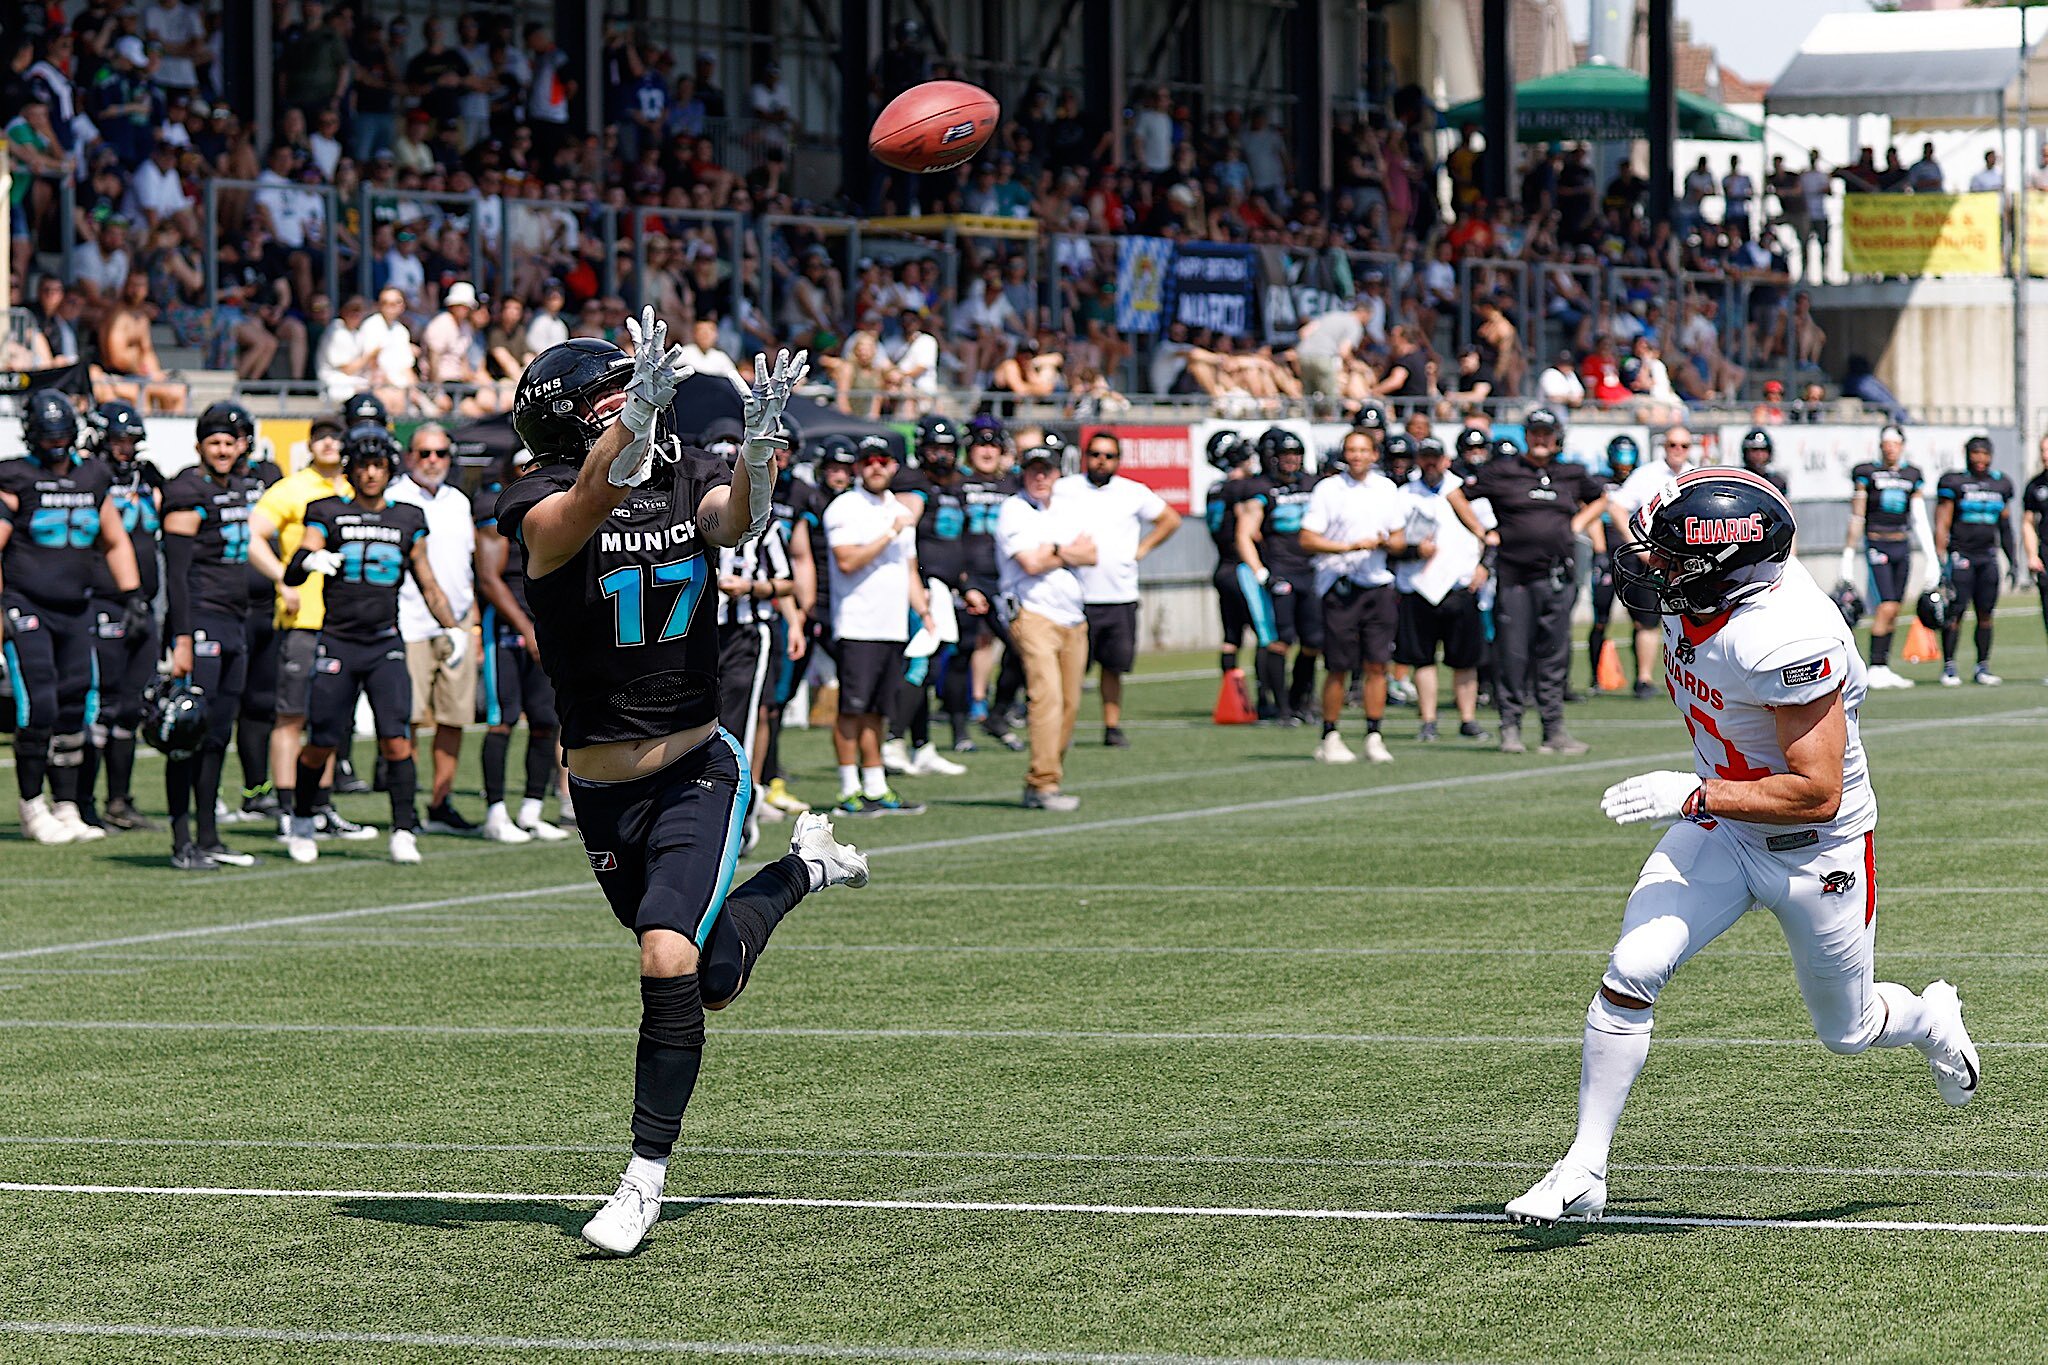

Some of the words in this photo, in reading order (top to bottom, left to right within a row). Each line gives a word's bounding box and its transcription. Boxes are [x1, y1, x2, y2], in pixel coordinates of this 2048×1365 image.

[515, 377, 562, 414] RAVENS
[633, 498, 668, 510] RAVENS
[1685, 513, 1763, 545] GUARDS
[337, 541, 404, 587] 13
[598, 550, 709, 648] 17
[1663, 642, 1724, 711] GUARDS
